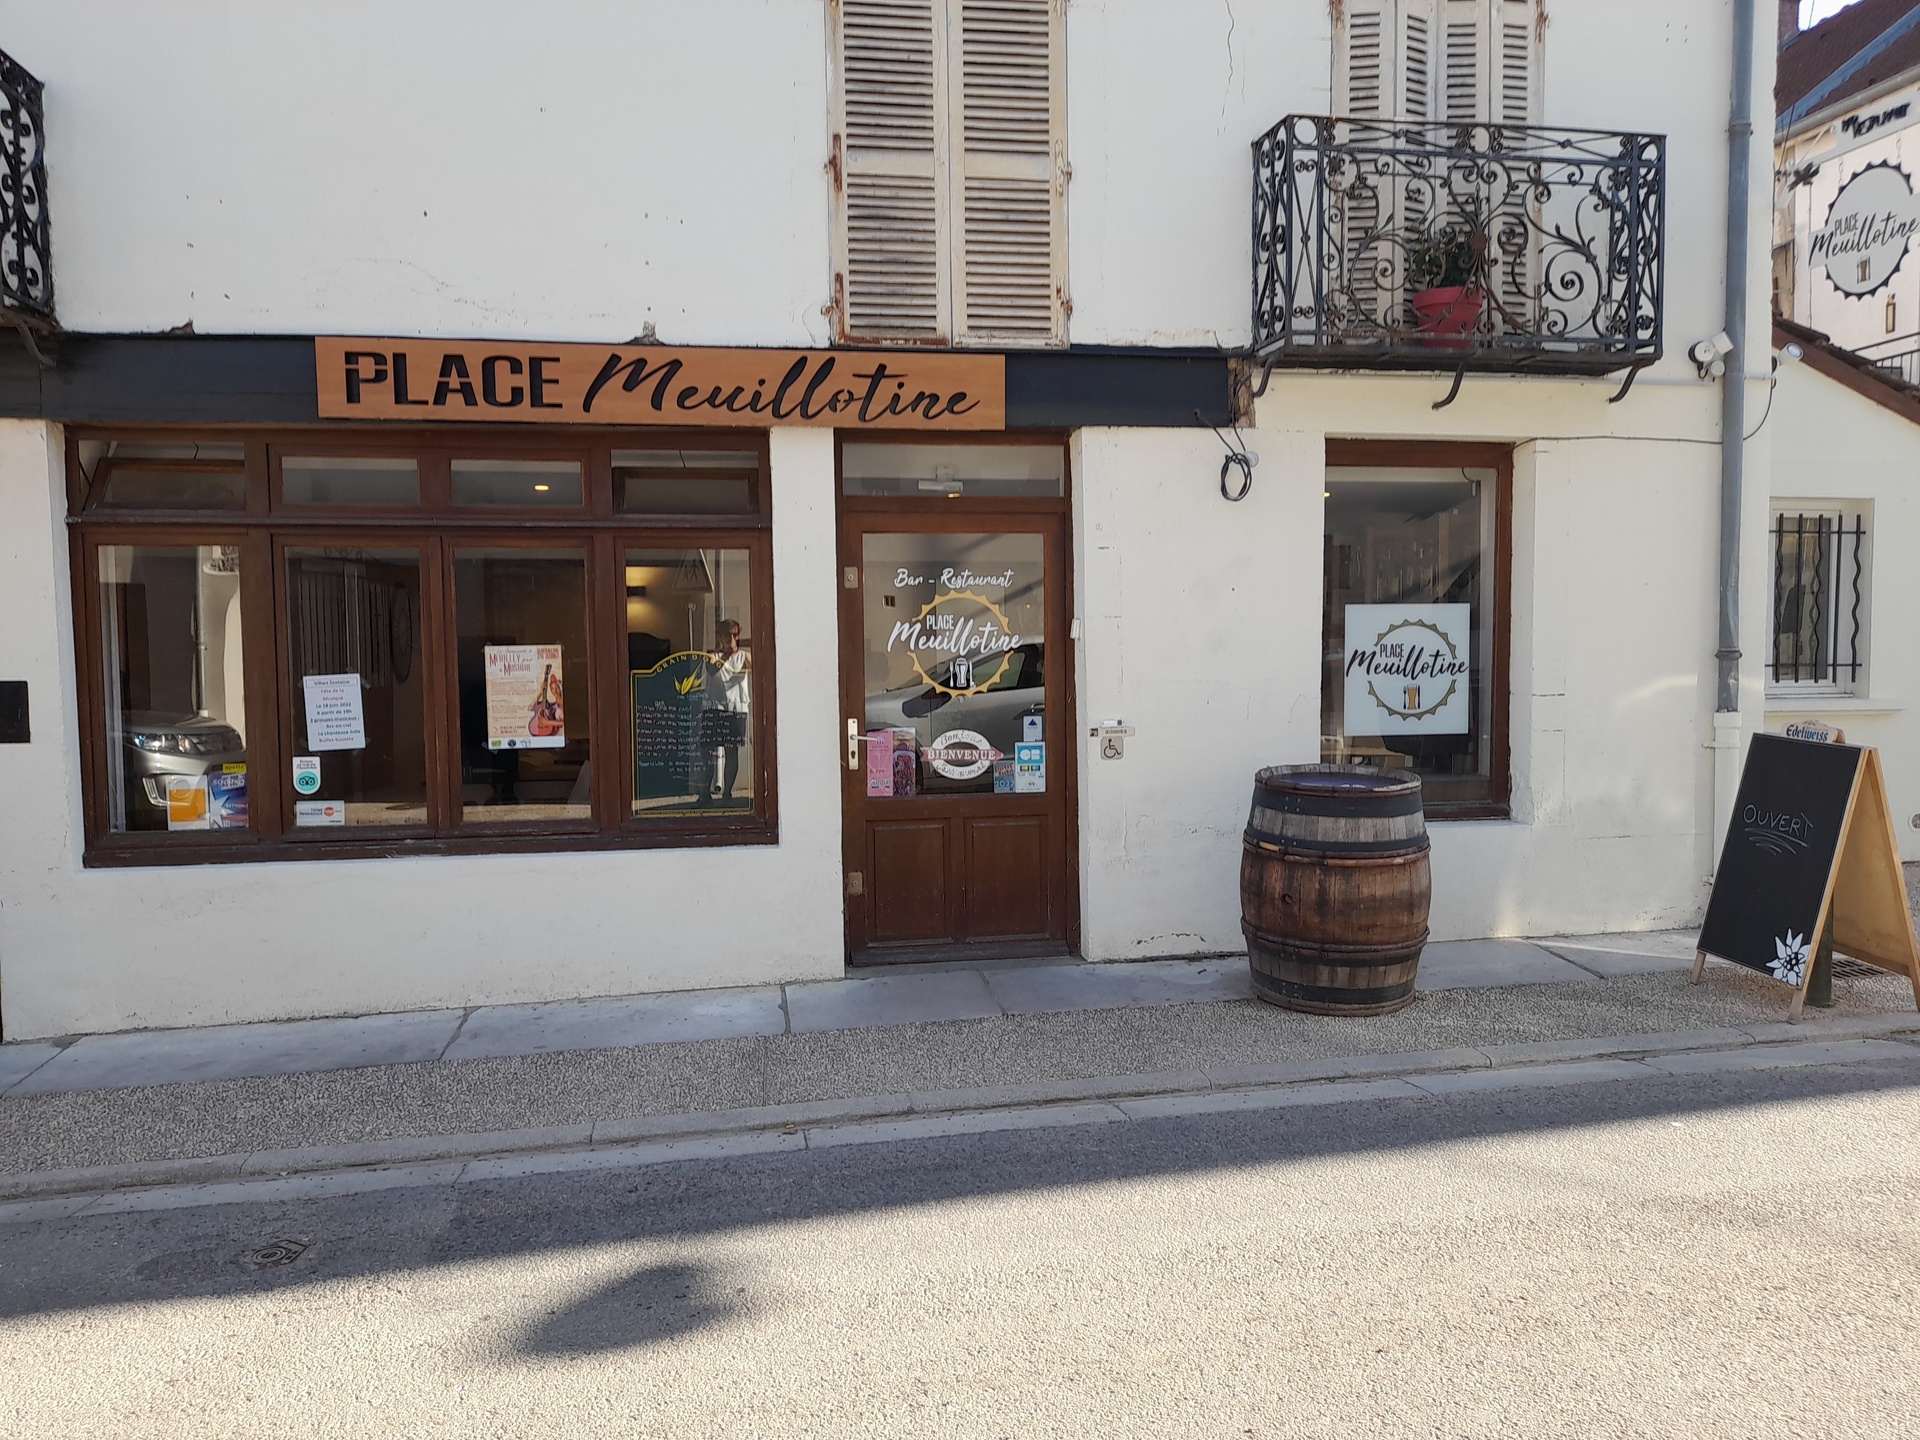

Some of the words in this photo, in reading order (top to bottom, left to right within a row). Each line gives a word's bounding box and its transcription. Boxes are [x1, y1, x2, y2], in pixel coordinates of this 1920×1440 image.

[1834, 212, 1859, 237] PLACE
[1808, 211, 1920, 267] Meuillotine
[344, 351, 564, 409] PLACE
[582, 353, 980, 423] Meuillotine
[893, 568, 923, 588] Bar
[940, 567, 1015, 589] Restaurant
[926, 614, 955, 630] PLACE
[887, 616, 1024, 656] Meuillotine
[1346, 644, 1469, 680] Meuillotine
[1380, 643, 1405, 658] PLACE
[656, 655, 687, 673] GRAIN
[1786, 724, 1829, 742] Edelweiss
[927, 749, 996, 760] BIENVENUE
[1743, 804, 1814, 838] OUVERT
